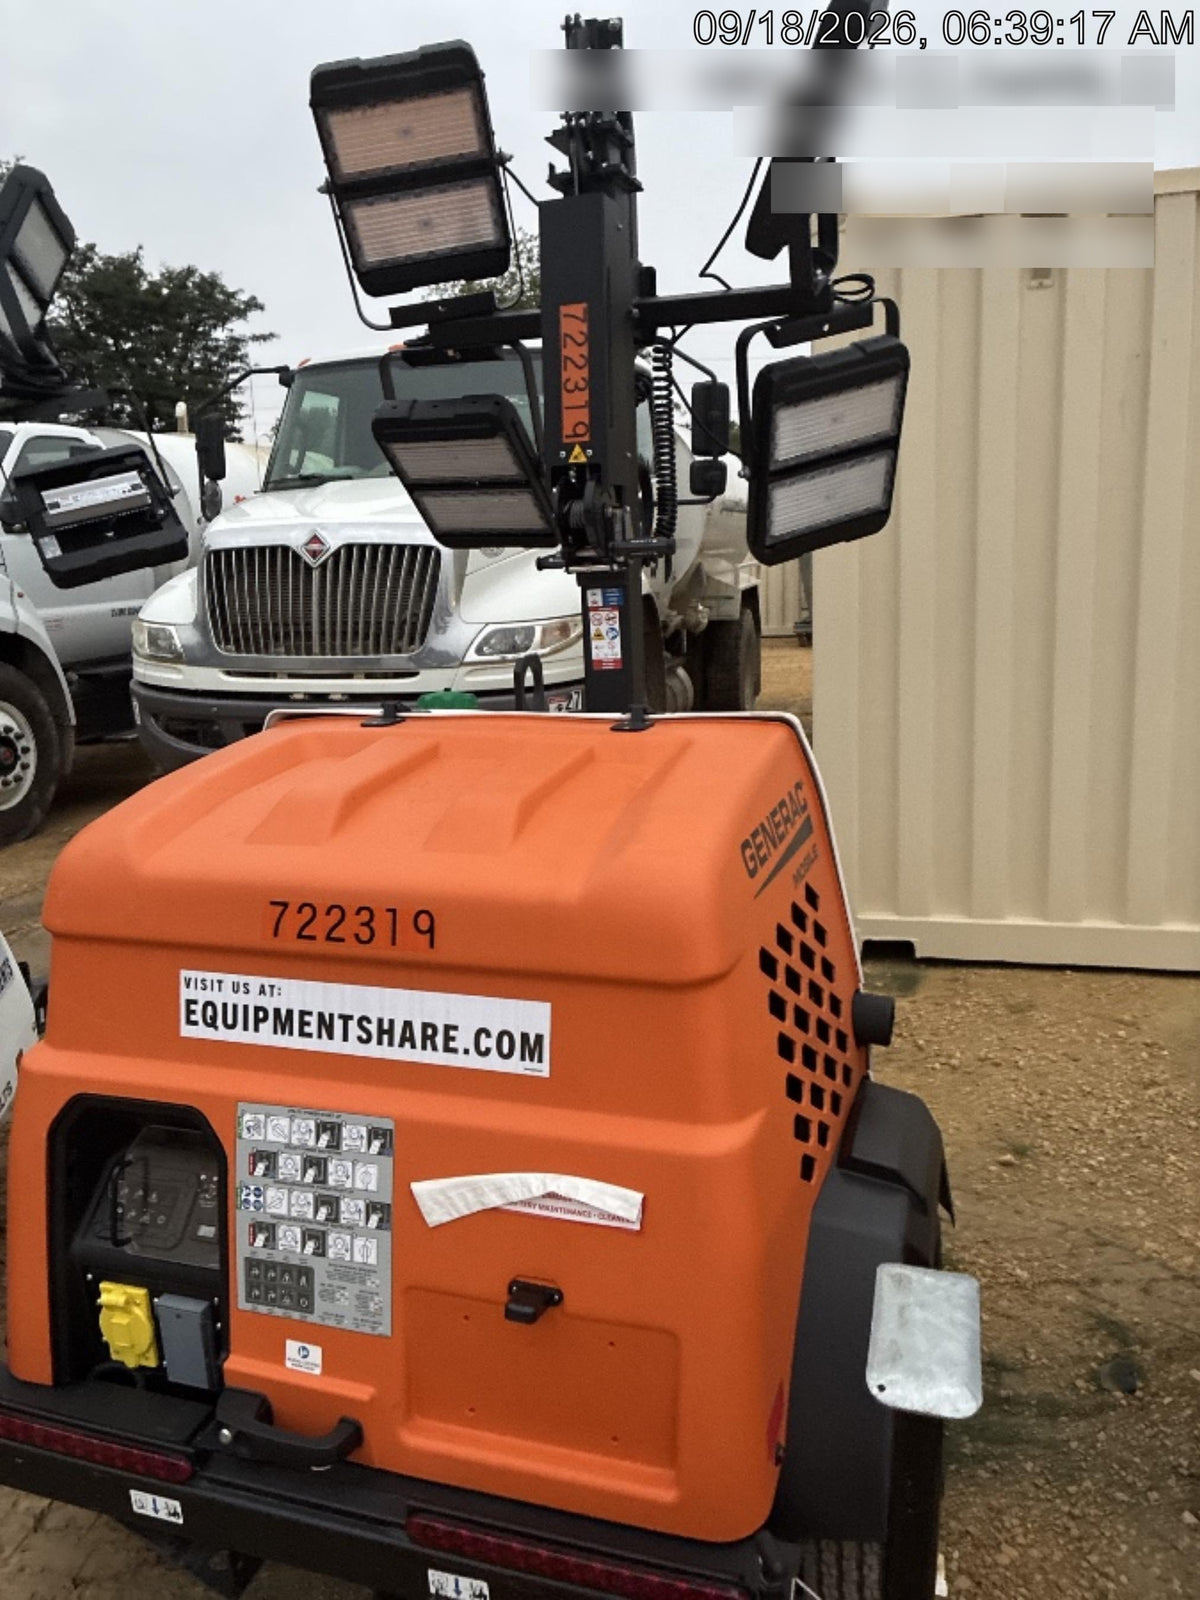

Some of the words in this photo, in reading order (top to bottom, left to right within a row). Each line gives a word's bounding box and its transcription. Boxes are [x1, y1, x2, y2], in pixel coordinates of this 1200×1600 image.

[562, 303, 588, 439] 722319
[741, 780, 808, 879] GENERAC
[269, 901, 436, 949] 722319
[184, 976, 223, 994] VISIT
[231, 981, 250, 995] US
[258, 984, 282, 997] AT:
[184, 999, 544, 1064] EQUIPMENTSHARE.COM
